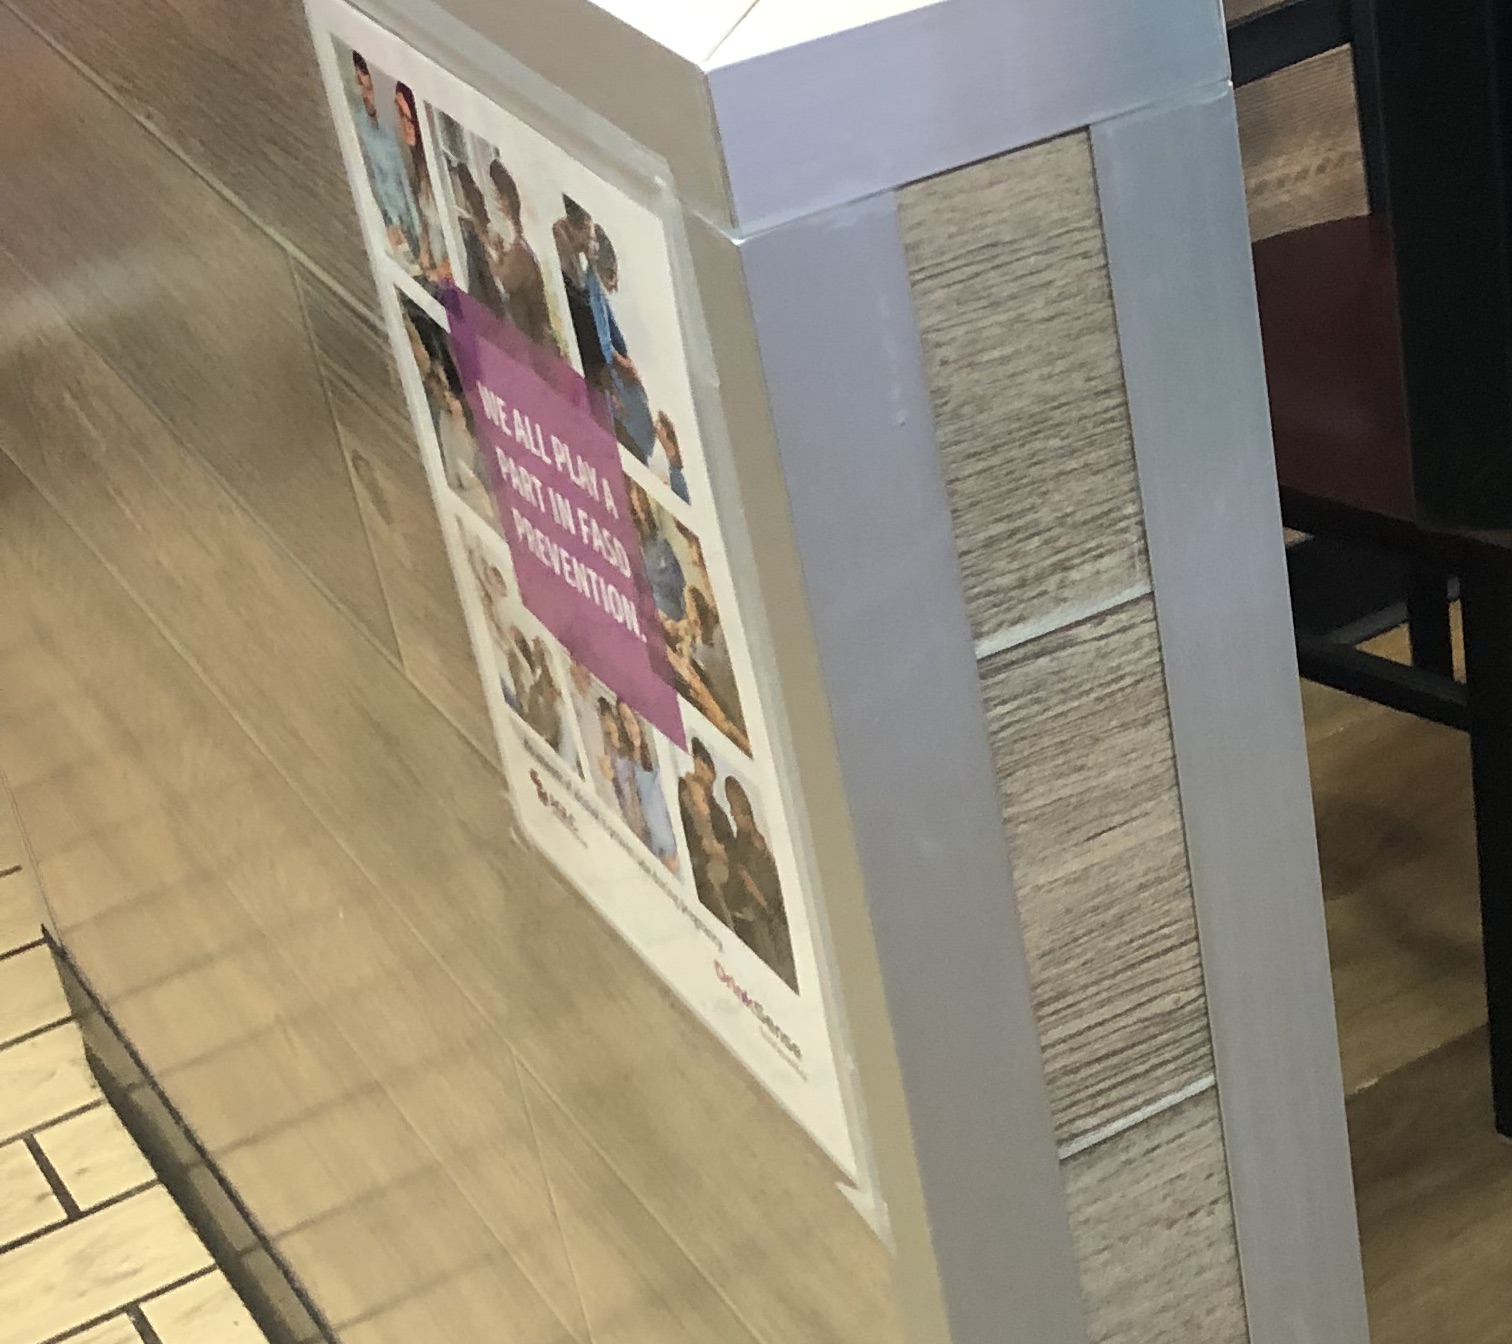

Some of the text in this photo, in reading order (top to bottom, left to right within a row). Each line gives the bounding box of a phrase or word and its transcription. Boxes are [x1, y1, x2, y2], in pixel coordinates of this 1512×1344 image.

[476, 380, 620, 520] WE ALL PLAY A
[494, 445, 546, 513] PART
[547, 486, 577, 536] IN
[511, 506, 648, 645] PREVENTION.
